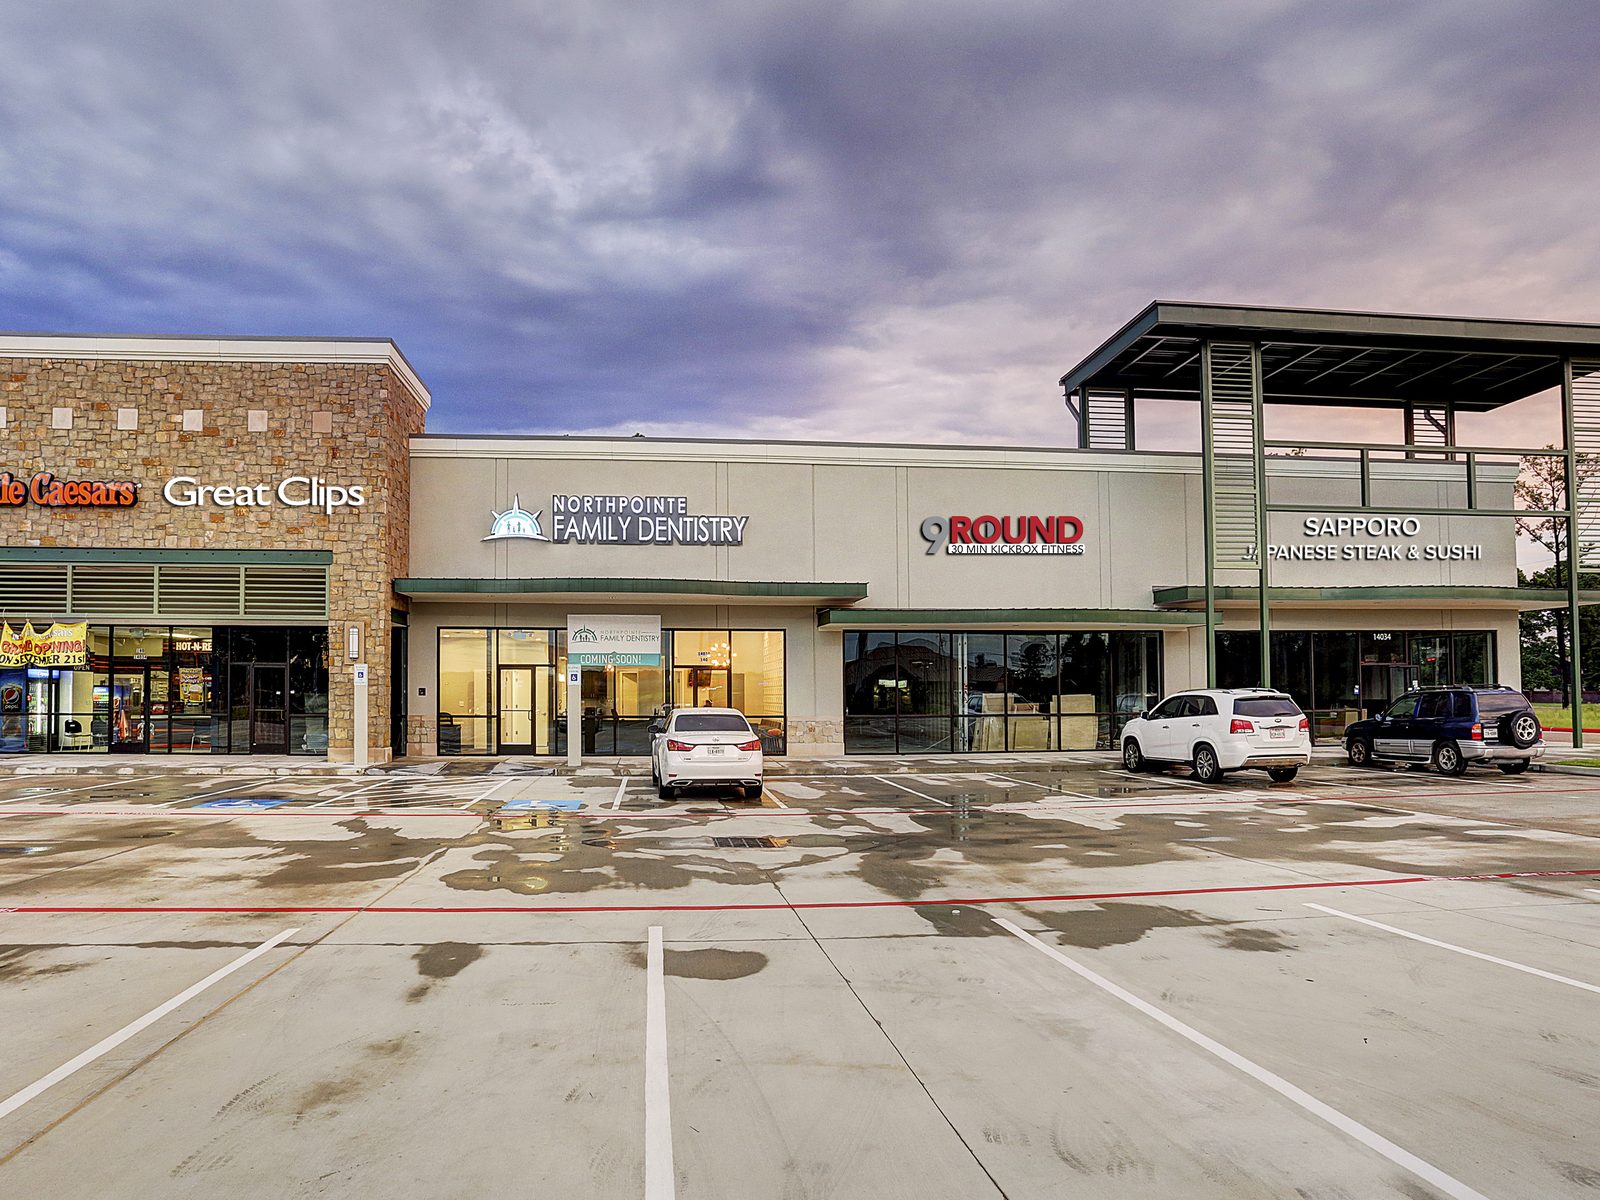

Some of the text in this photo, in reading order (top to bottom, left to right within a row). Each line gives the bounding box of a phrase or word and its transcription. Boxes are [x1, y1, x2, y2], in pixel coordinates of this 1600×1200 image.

[30, 472, 135, 505] Caesars
[163, 476, 365, 515] Great Clips
[553, 496, 687, 514] NORTHPOINTE
[553, 515, 747, 542] FAMILY DENTISTRY
[921, 515, 1084, 555] 9ROUND
[1304, 517, 1421, 536] SAPPORO
[951, 544, 1084, 554] 30 MIN KICKBOX FITNESS
[1342, 544, 1402, 560] STEAK
[1407, 544, 1421, 560] &
[1425, 545, 1482, 560] SUSHI
[600, 634, 660, 642] FAMILY DENTISTRY
[1373, 633, 1392, 641] 14034
[175, 641, 212, 651] HOT-N-RE
[580, 654, 641, 664] COMING SOON!
